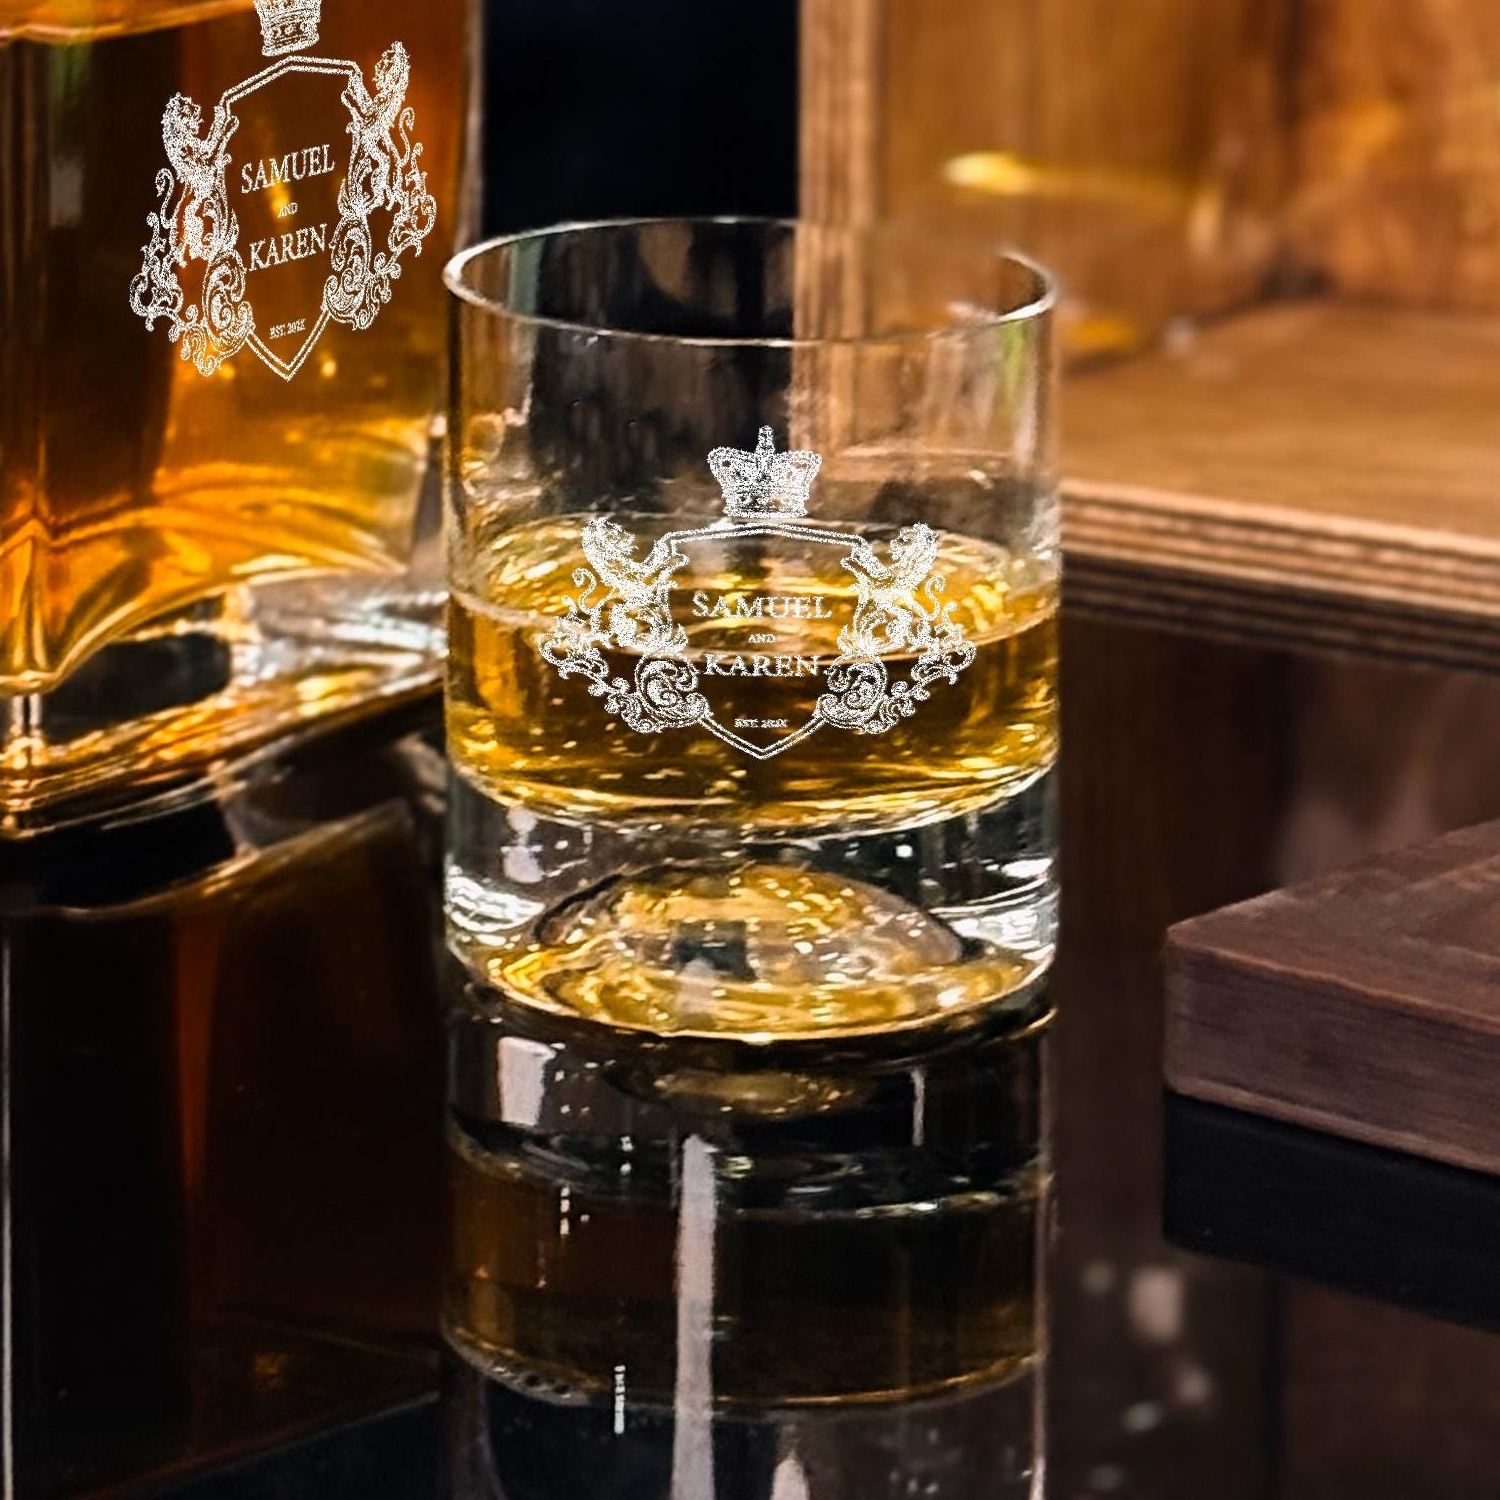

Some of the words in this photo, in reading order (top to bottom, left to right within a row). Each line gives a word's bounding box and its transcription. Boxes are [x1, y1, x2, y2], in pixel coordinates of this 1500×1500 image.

[241, 144, 336, 194] SAMUEL
[277, 202, 299, 219] AND
[249, 223, 328, 272] KAREN
[692, 590, 833, 619] SAMUEL
[748, 633, 777, 644] AND
[702, 653, 821, 678] KAREN
